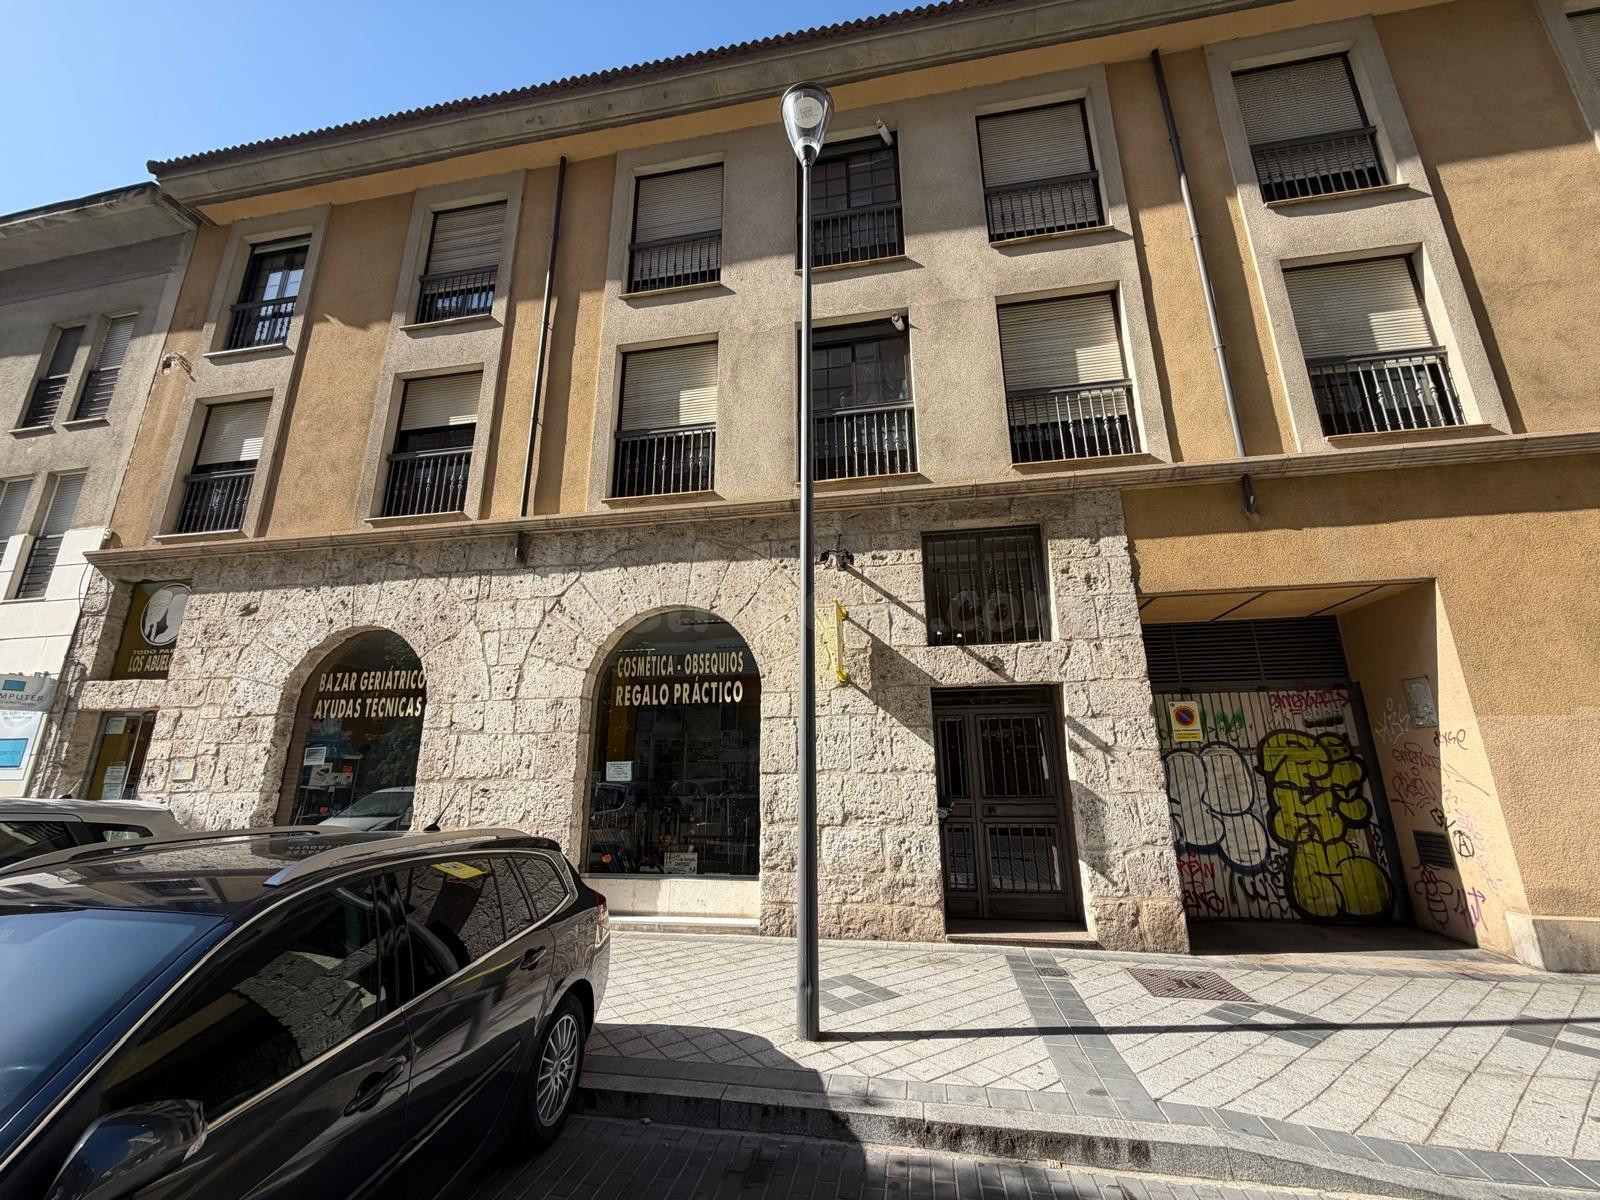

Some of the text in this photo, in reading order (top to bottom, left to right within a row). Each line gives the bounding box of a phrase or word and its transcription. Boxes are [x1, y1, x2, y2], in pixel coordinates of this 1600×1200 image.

[128, 655, 145, 672] LOS
[617, 649, 674, 678] COSMÉTICA
[684, 651, 744, 676] OBSEQUIOS
[318, 665, 426, 692] BAZAR GERIÁTRICO
[615, 675, 744, 707] REGALO PRÁCTICO
[314, 691, 423, 719] AYUDAS TÉCNICAS
